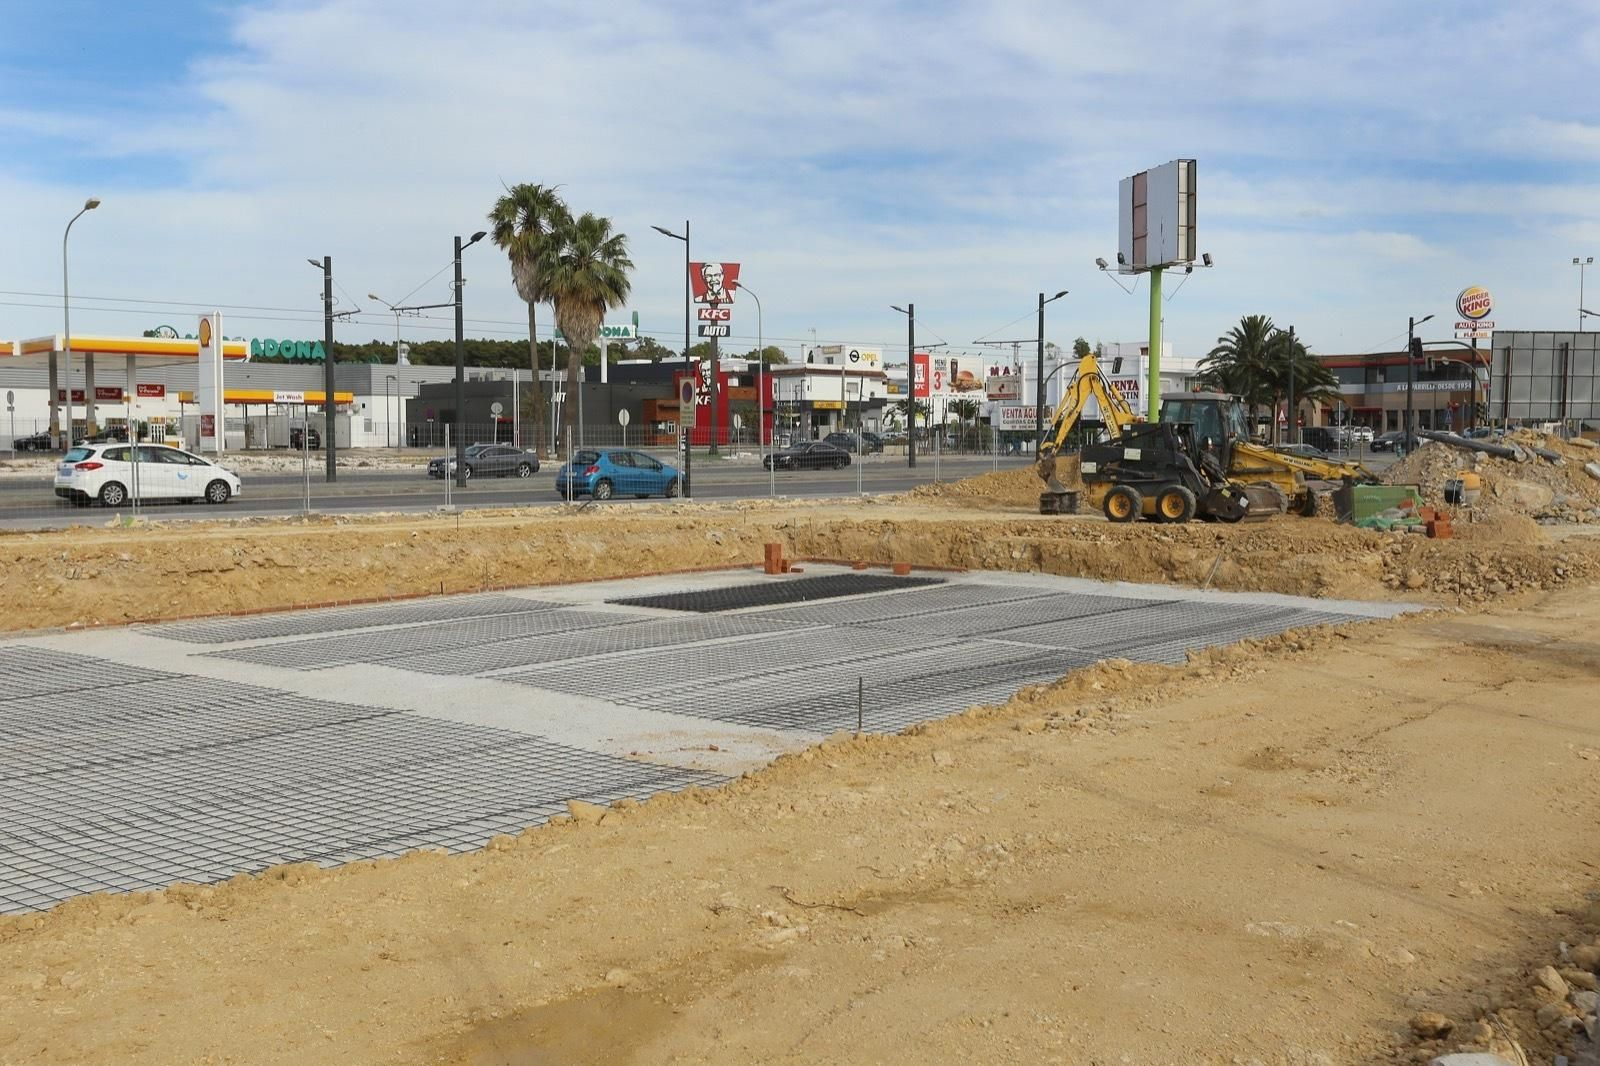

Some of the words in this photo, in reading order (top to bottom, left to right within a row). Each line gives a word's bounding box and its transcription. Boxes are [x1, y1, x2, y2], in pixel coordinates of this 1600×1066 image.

[1462, 292, 1489, 305] BURGER
[1463, 299, 1490, 314] KING
[700, 309, 729, 320] KFC
[703, 325, 727, 337] AUTO
[861, 353, 879, 363] OPEL
[934, 371, 941, 390] 3
[696, 395, 713, 406] KF
[1002, 407, 1023, 419] VENTA
